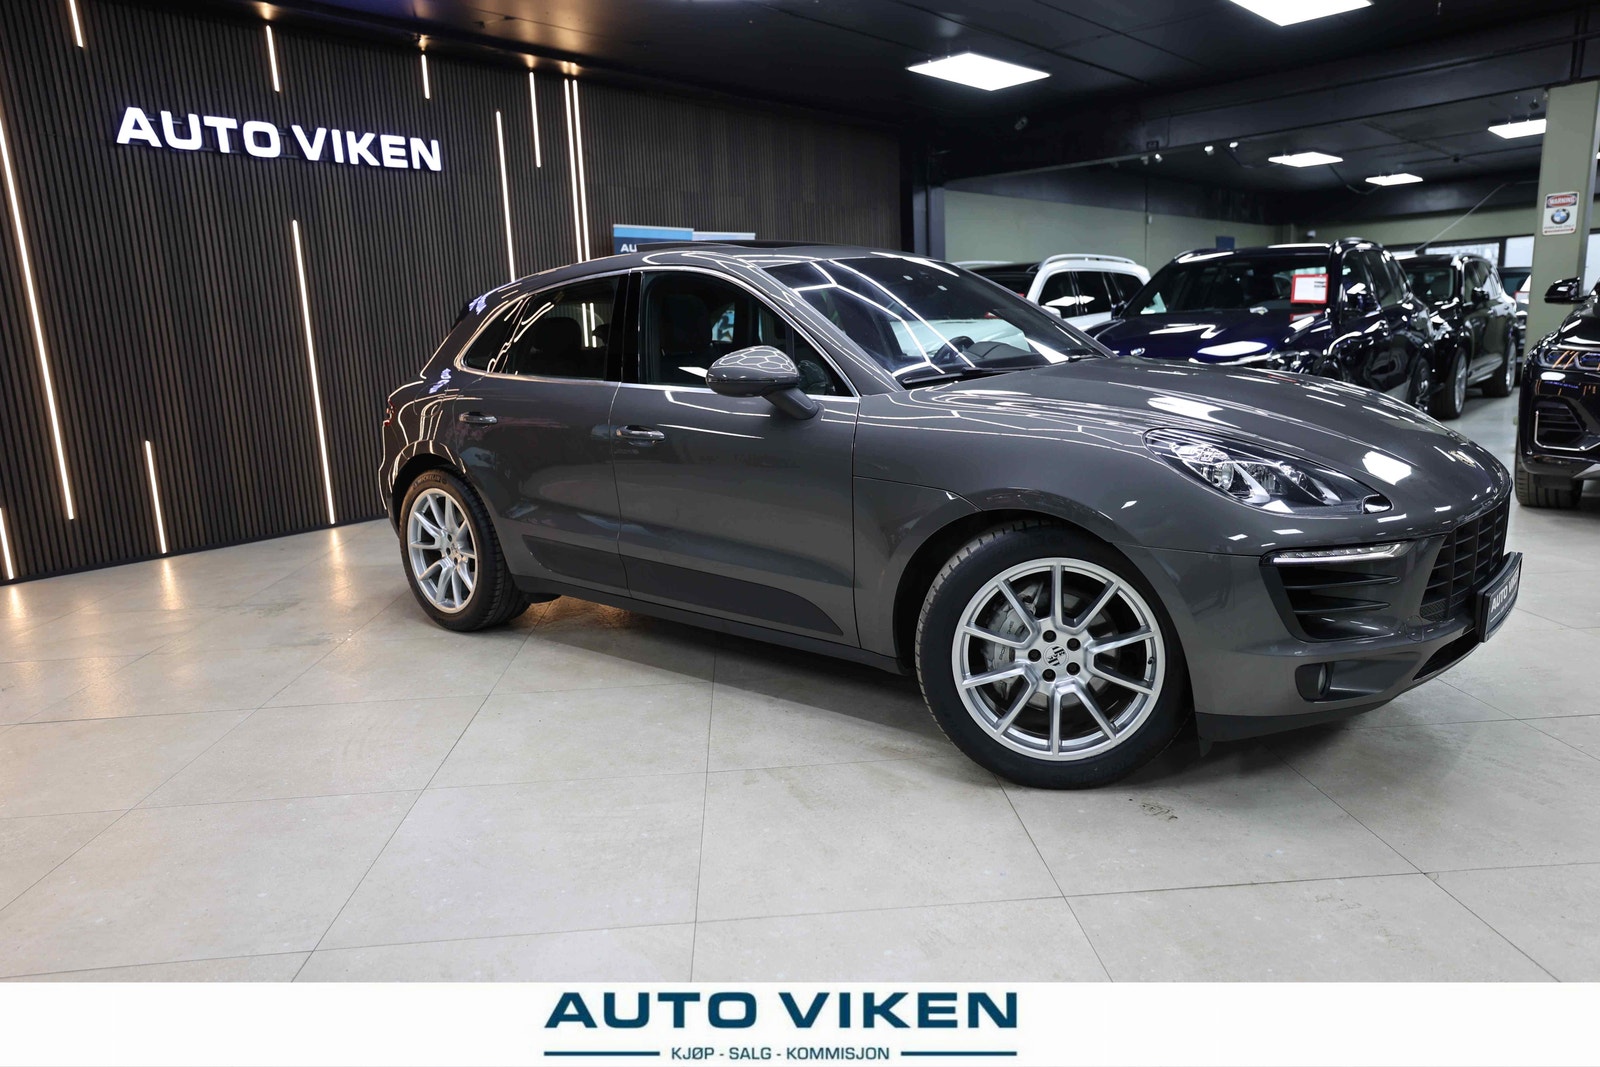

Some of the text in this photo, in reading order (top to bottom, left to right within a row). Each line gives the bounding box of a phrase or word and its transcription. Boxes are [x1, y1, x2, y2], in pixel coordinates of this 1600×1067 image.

[116, 106, 442, 172] AUTO VIKEN
[1491, 584, 1508, 613] AUTO
